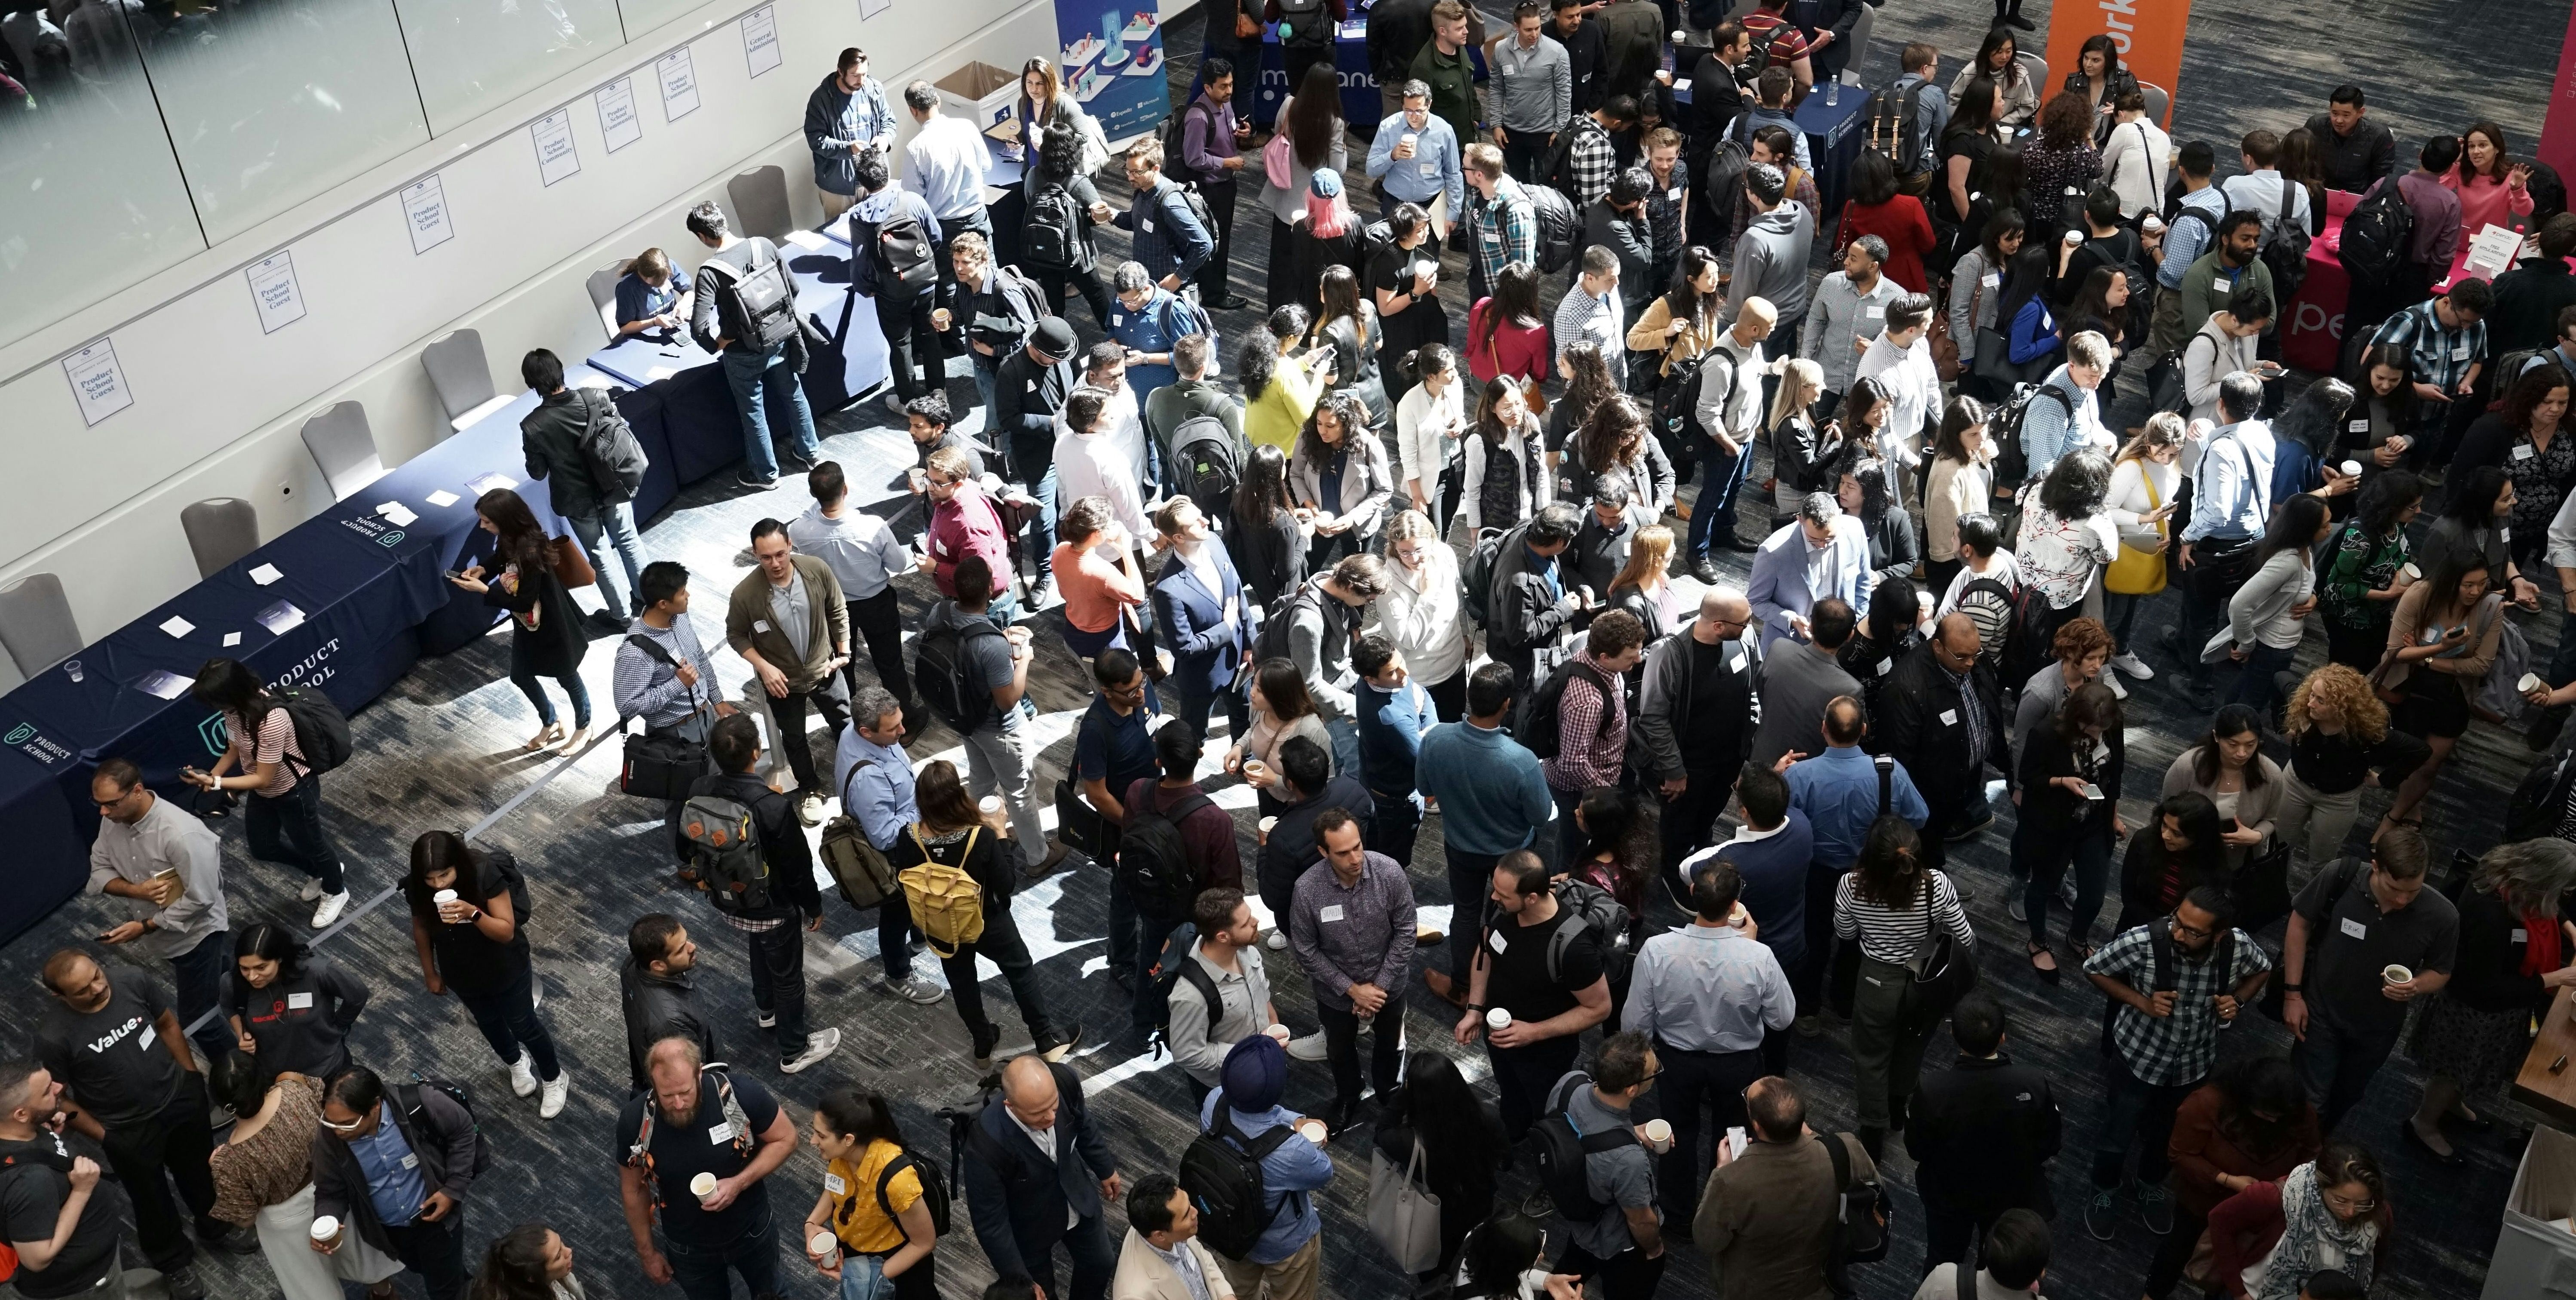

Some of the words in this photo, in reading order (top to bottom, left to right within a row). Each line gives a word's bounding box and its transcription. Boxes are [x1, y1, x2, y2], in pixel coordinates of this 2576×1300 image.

[750, 31, 771, 46] General
[2099, 0, 2136, 70] ork
[749, 37, 776, 54] Admission
[668, 74, 687, 87] Product
[671, 80, 687, 92] School
[666, 84, 694, 101] Community
[1144, 97, 1159, 105] Microsoft
[607, 104, 627, 117] Product
[610, 111, 627, 123] School
[1117, 108, 1132, 116] Expedia
[605, 114, 635, 132] Community
[1839, 111, 1857, 130] PRODUCT
[1838, 122, 1853, 138] SCHOOL
[544, 138, 565, 151] Product
[547, 144, 565, 156] School
[542, 147, 573, 165] Community
[413, 203, 439, 219] Product
[417, 210, 439, 225] School
[420, 218, 440, 231] Guest
[2496, 232, 2512, 240] pendo
[261, 280, 289, 298] Product
[266, 287, 289, 304] School
[269, 295, 291, 310] Guest
[80, 368, 113, 388] Product
[86, 377, 114, 395] School
[91, 385, 115, 400] Guest
[341, 520, 377, 537] PRODUCT
[356, 517, 386, 532] SCHOOL
[267, 638, 340, 689] ODUCT
[23, 744, 54, 764] SCHOOL
[34, 736, 71, 759] PRODUCT
[2344, 922, 2360, 934] ERIK
[88, 1017, 138, 1053] Value
